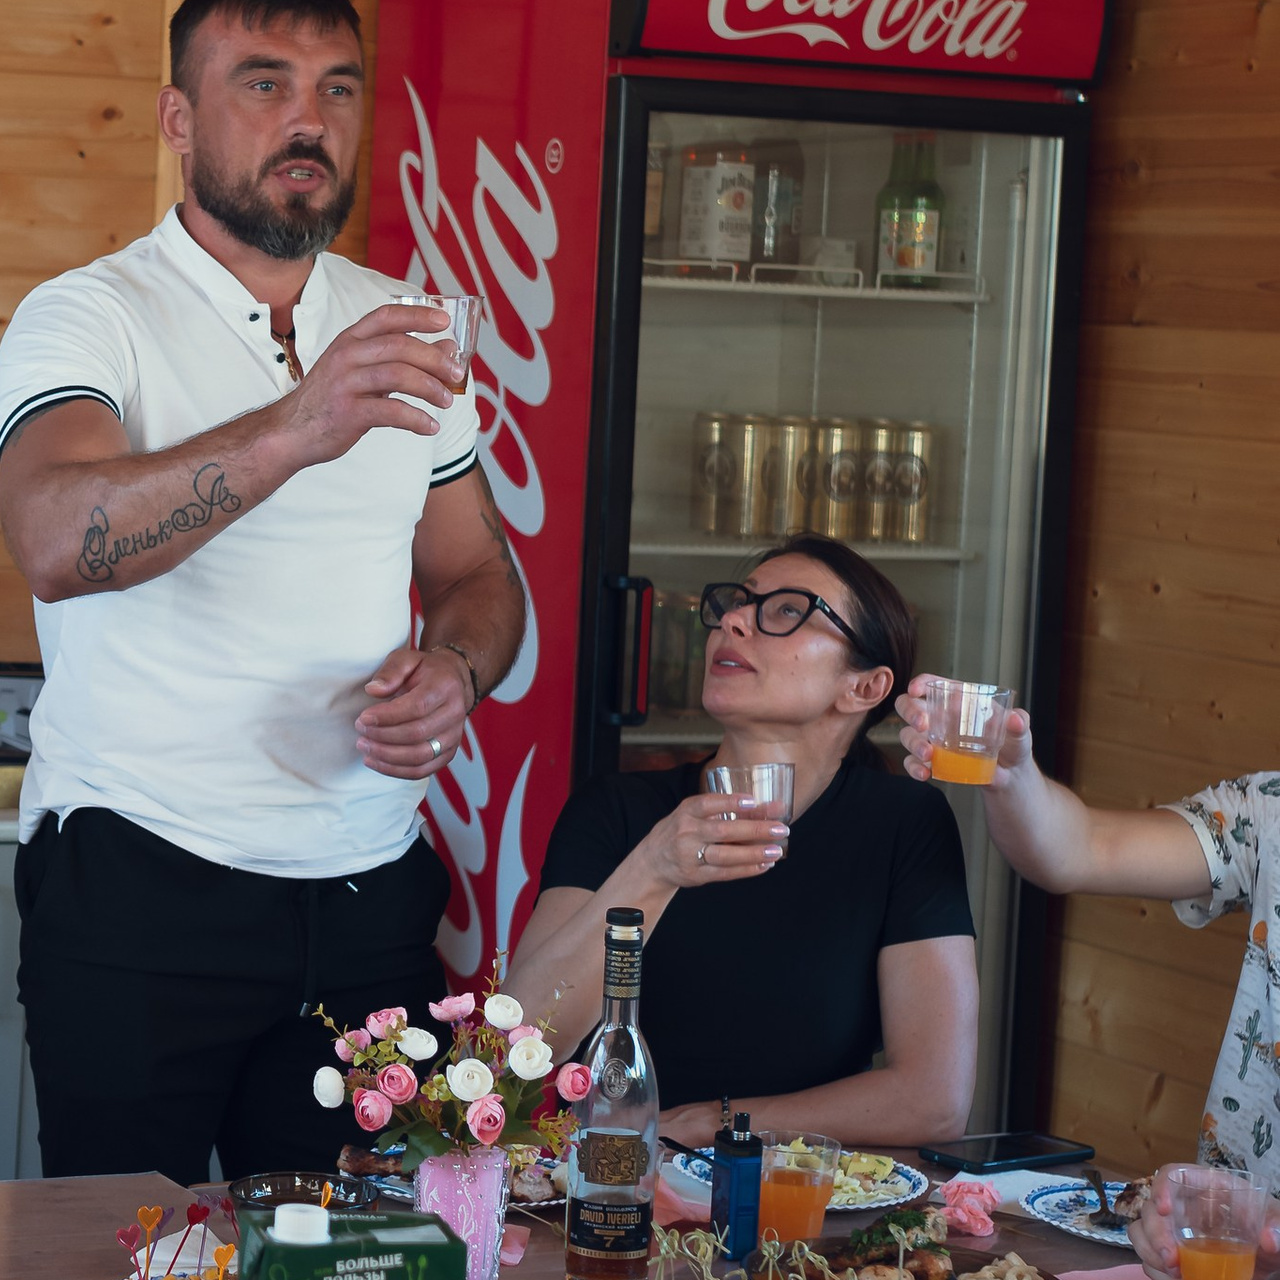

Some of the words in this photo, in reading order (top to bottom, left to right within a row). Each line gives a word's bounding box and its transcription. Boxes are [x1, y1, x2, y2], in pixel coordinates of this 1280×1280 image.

[580, 1209, 604, 1223] DAVID
[603, 1236, 615, 1248] 7
[336, 1253, 404, 1273] БОЛЬШЕ
